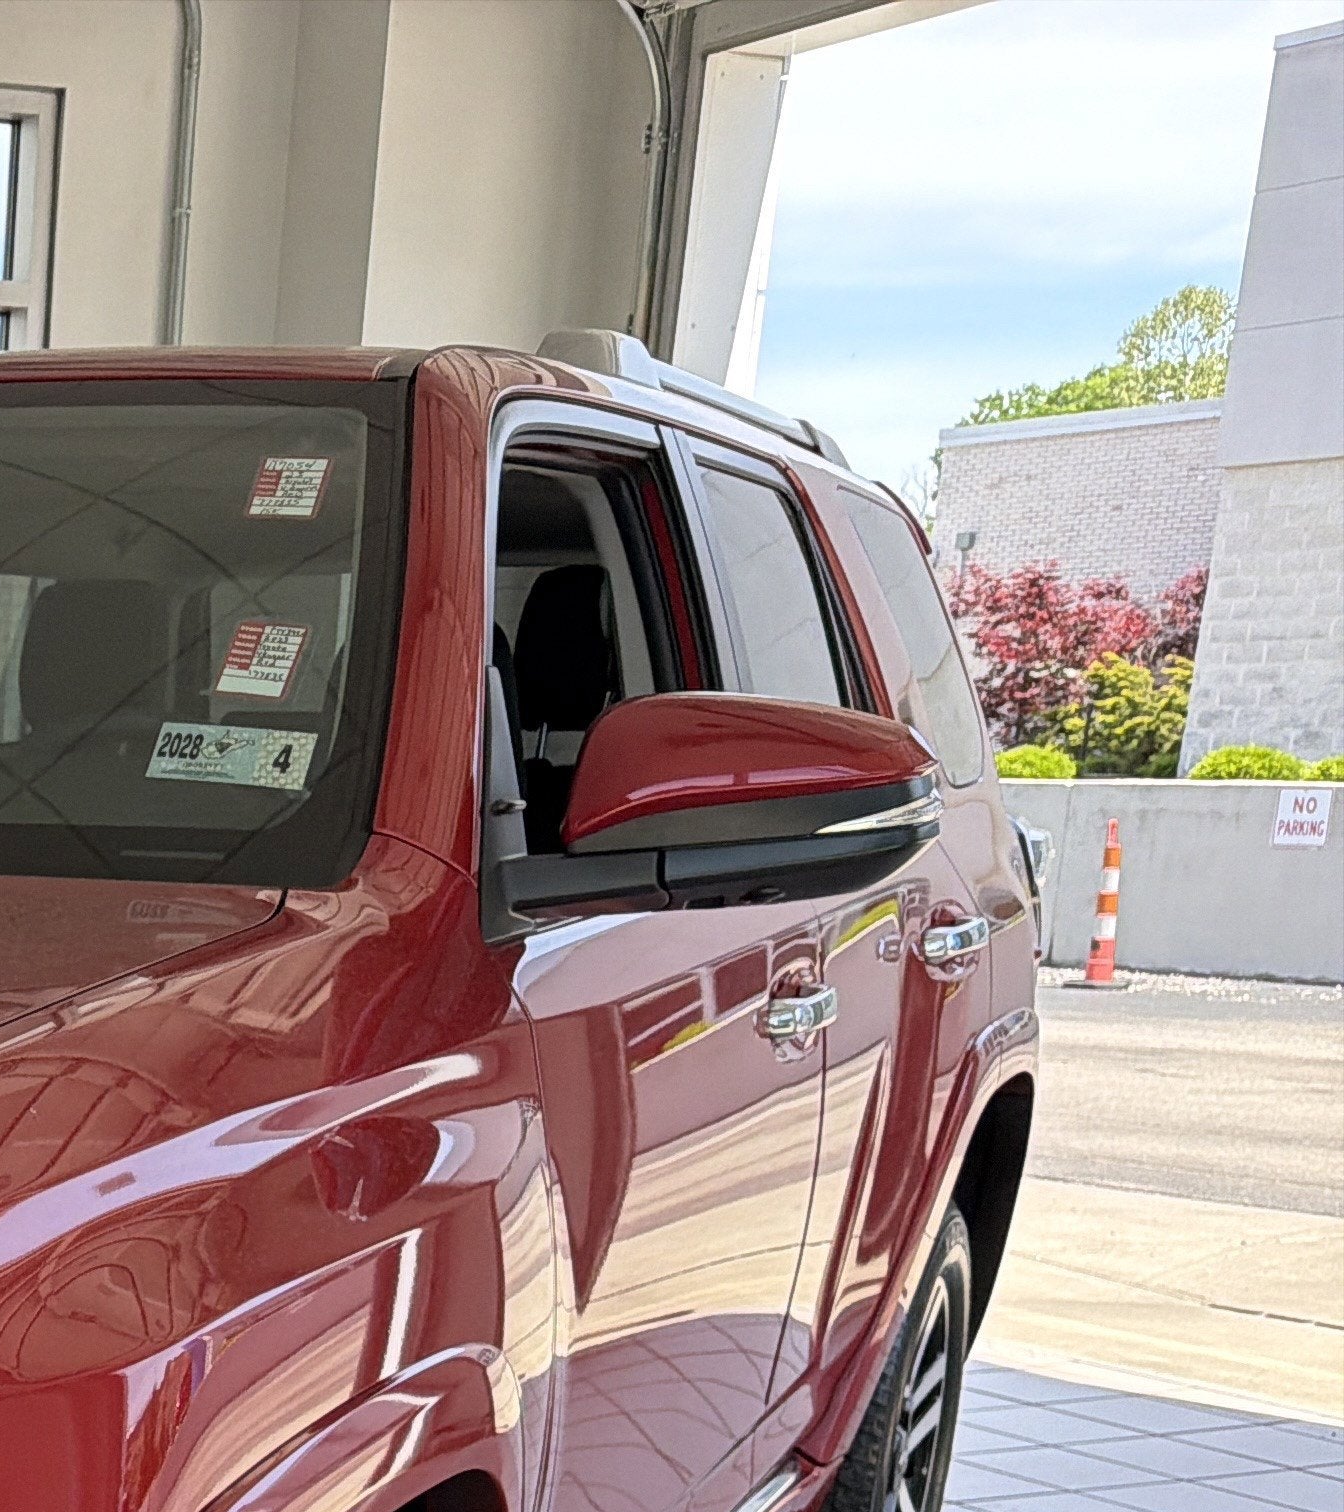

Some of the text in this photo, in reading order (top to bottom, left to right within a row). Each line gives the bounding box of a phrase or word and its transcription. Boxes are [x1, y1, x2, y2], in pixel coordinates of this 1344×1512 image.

[157, 731, 293, 774] 2028 4
[1292, 796, 1318, 814] NO
[1276, 819, 1326, 837] PARKING
